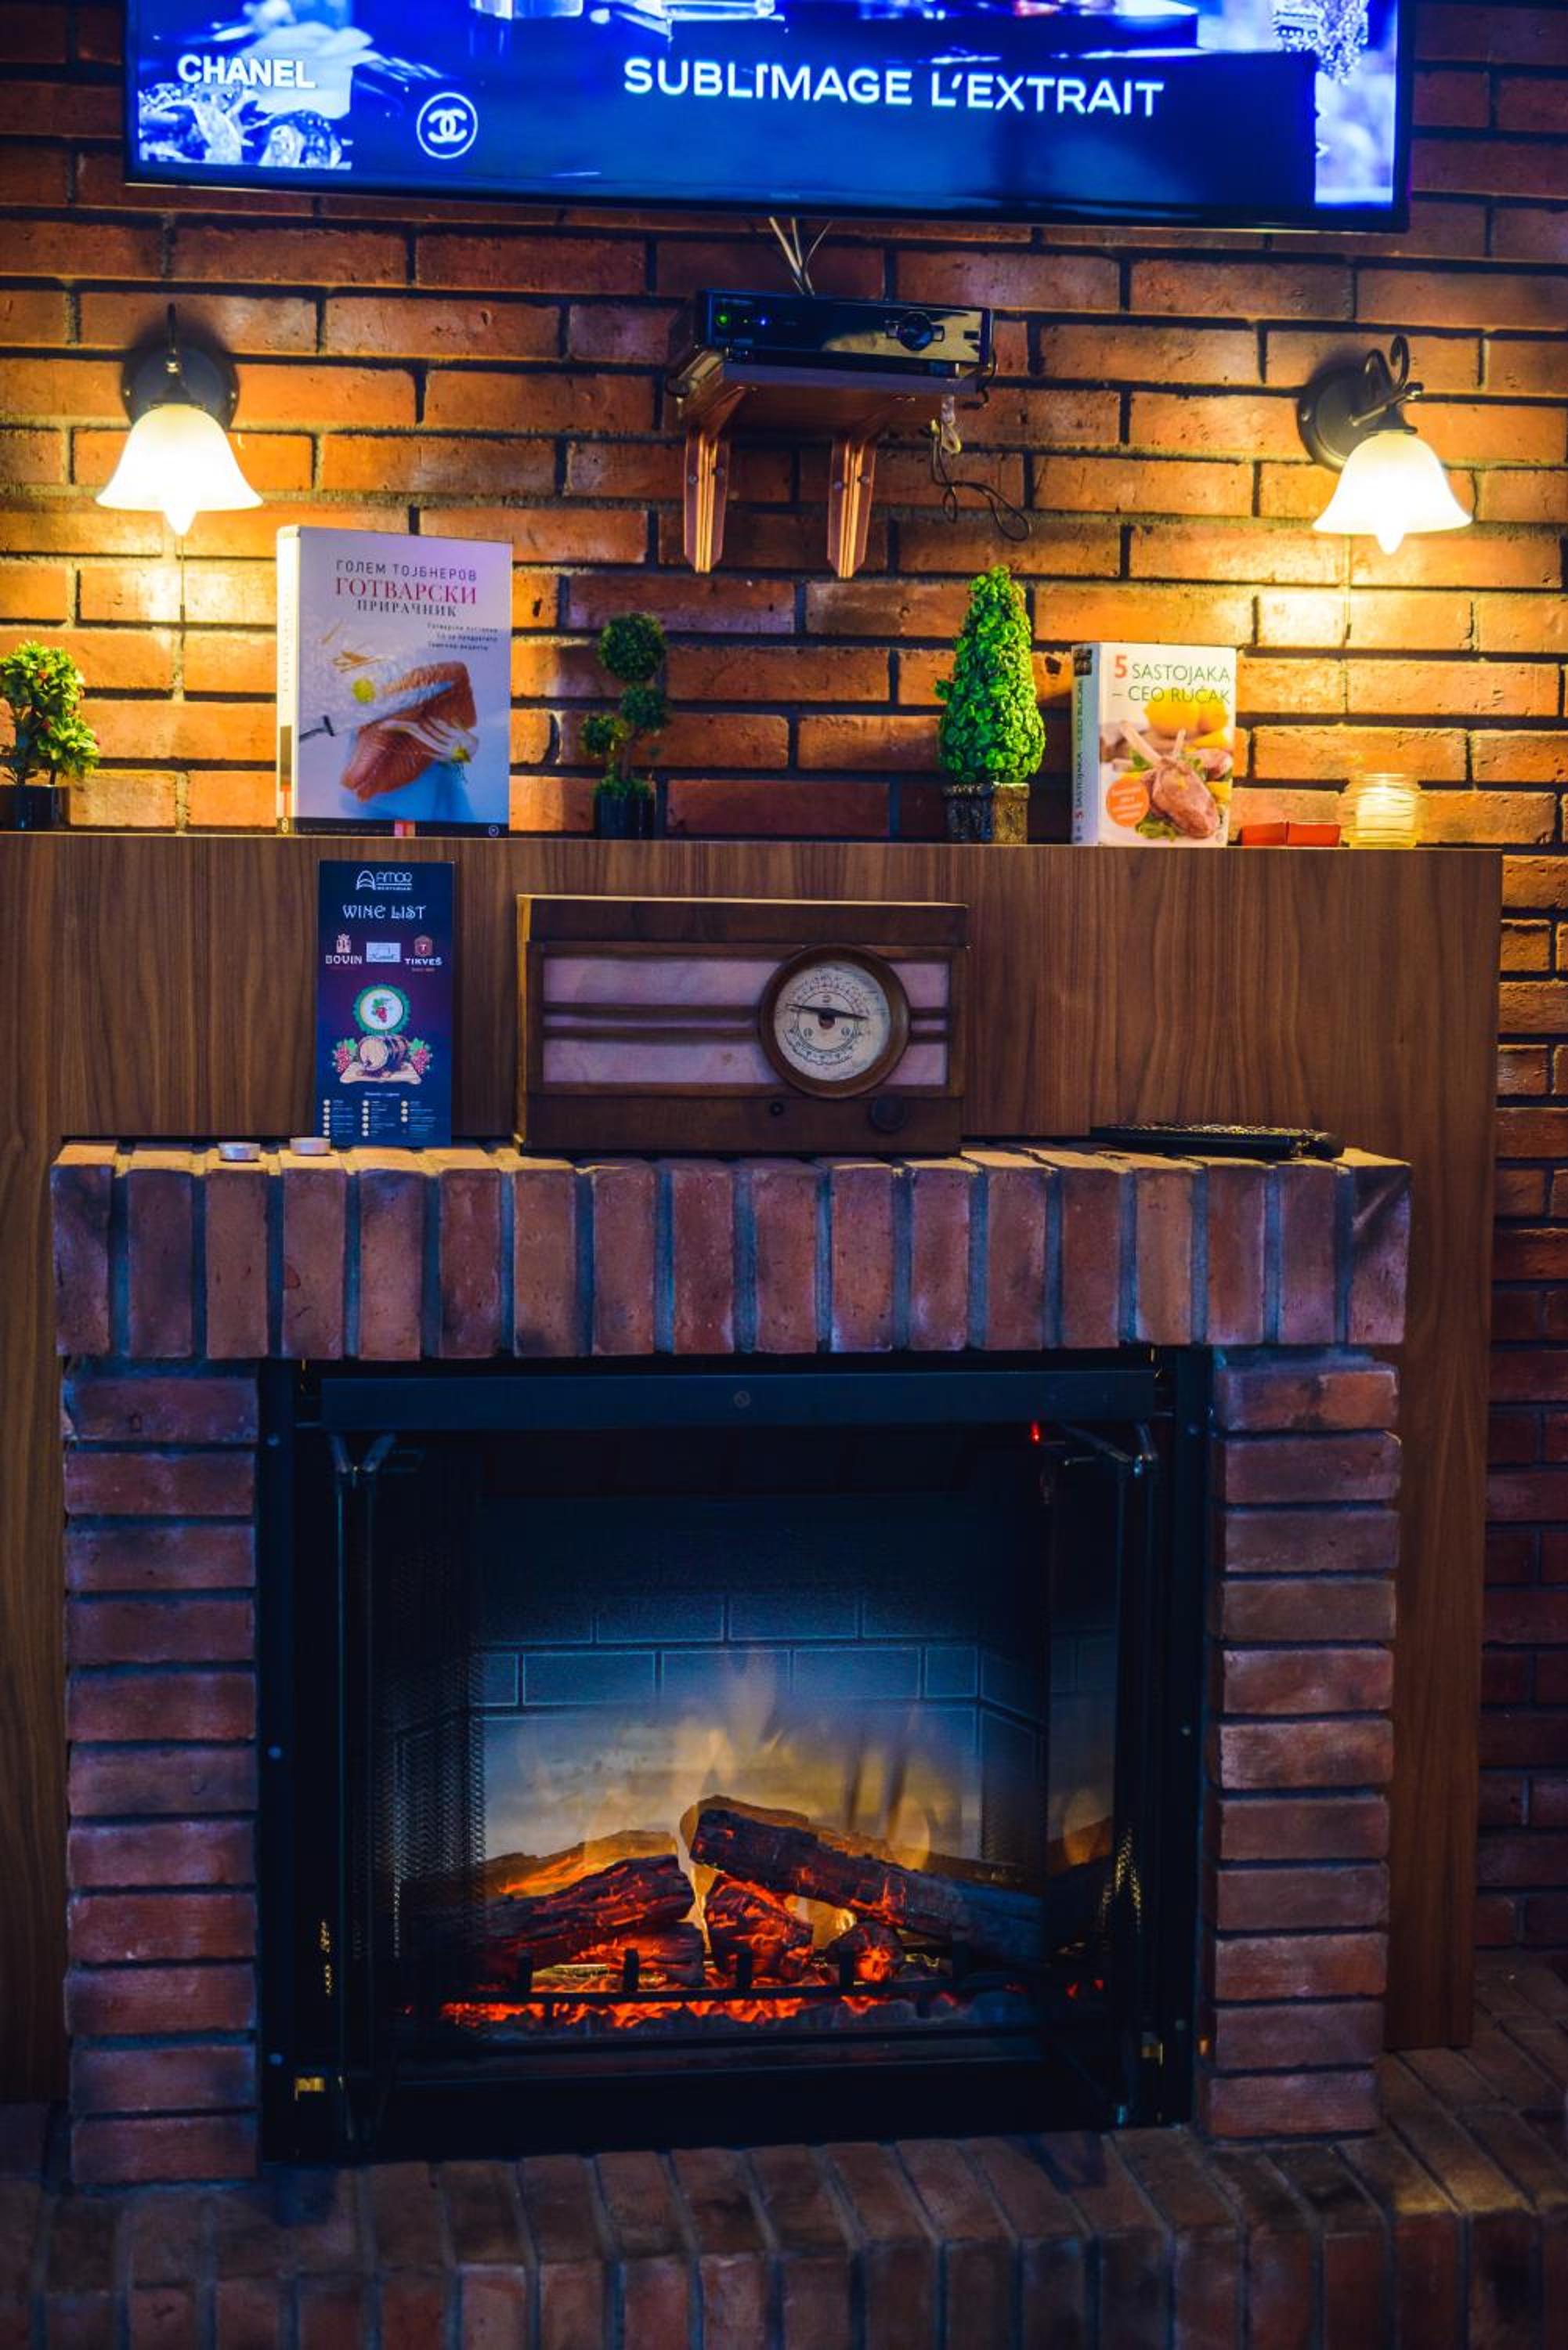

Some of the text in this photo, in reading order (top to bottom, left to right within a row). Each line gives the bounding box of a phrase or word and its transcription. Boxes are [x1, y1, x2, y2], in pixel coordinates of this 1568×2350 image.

[177, 54, 316, 89] CHANEL
[624, 58, 1165, 118] SUBLIMAGE L'EXTRAIT
[335, 559, 477, 581] ГОЛЕМ ТОЈБНЕРОВ
[335, 577, 477, 606] ГОТВАРСКИ
[356, 598, 457, 618] ПРИРАЧНИК
[1114, 654, 1230, 685] 5 SASTOJAKA
[1128, 685, 1165, 703] CEO
[342, 904, 427, 920] WINE LIST
[325, 954, 363, 965] BOVIN
